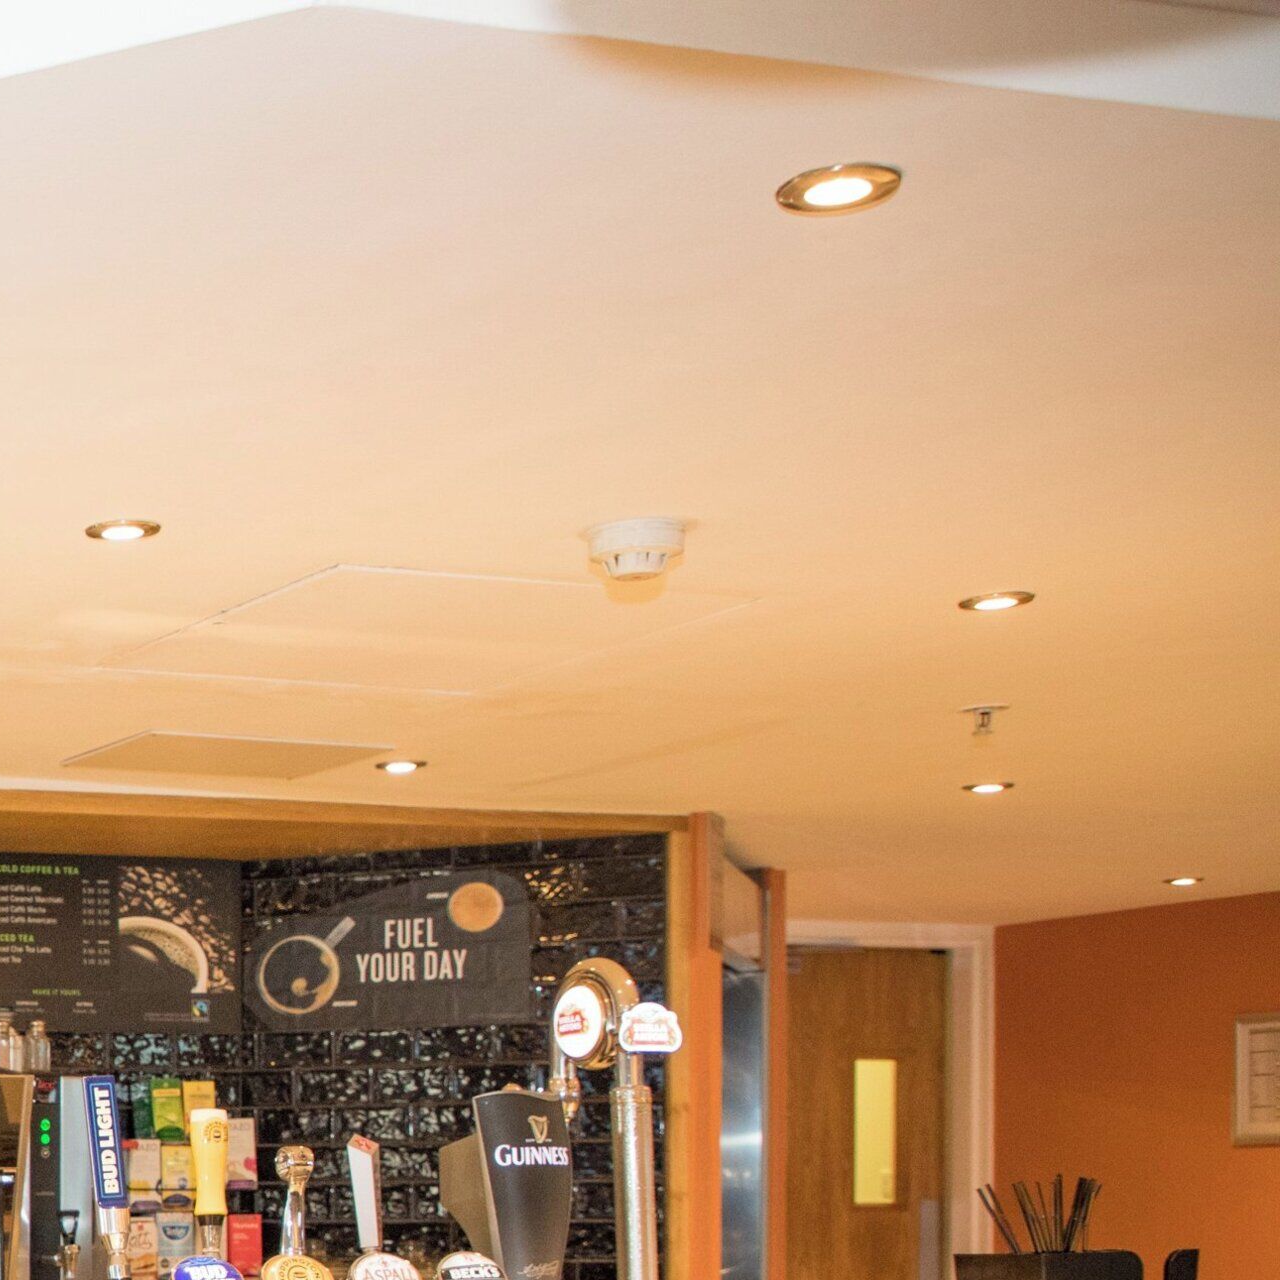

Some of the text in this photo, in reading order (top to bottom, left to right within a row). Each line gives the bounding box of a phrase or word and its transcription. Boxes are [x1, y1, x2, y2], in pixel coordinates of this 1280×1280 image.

[20, 865, 52, 874] COFFEE
[63, 866, 79, 875] TEA
[18, 934, 34, 942] TEA
[383, 917, 438, 950] FUEL
[356, 948, 468, 984] YOUR DAY
[93, 1087, 120, 1195] BUD LIGHT
[494, 1144, 570, 1166] GUINNESS
[184, 1264, 228, 1280] BUD
